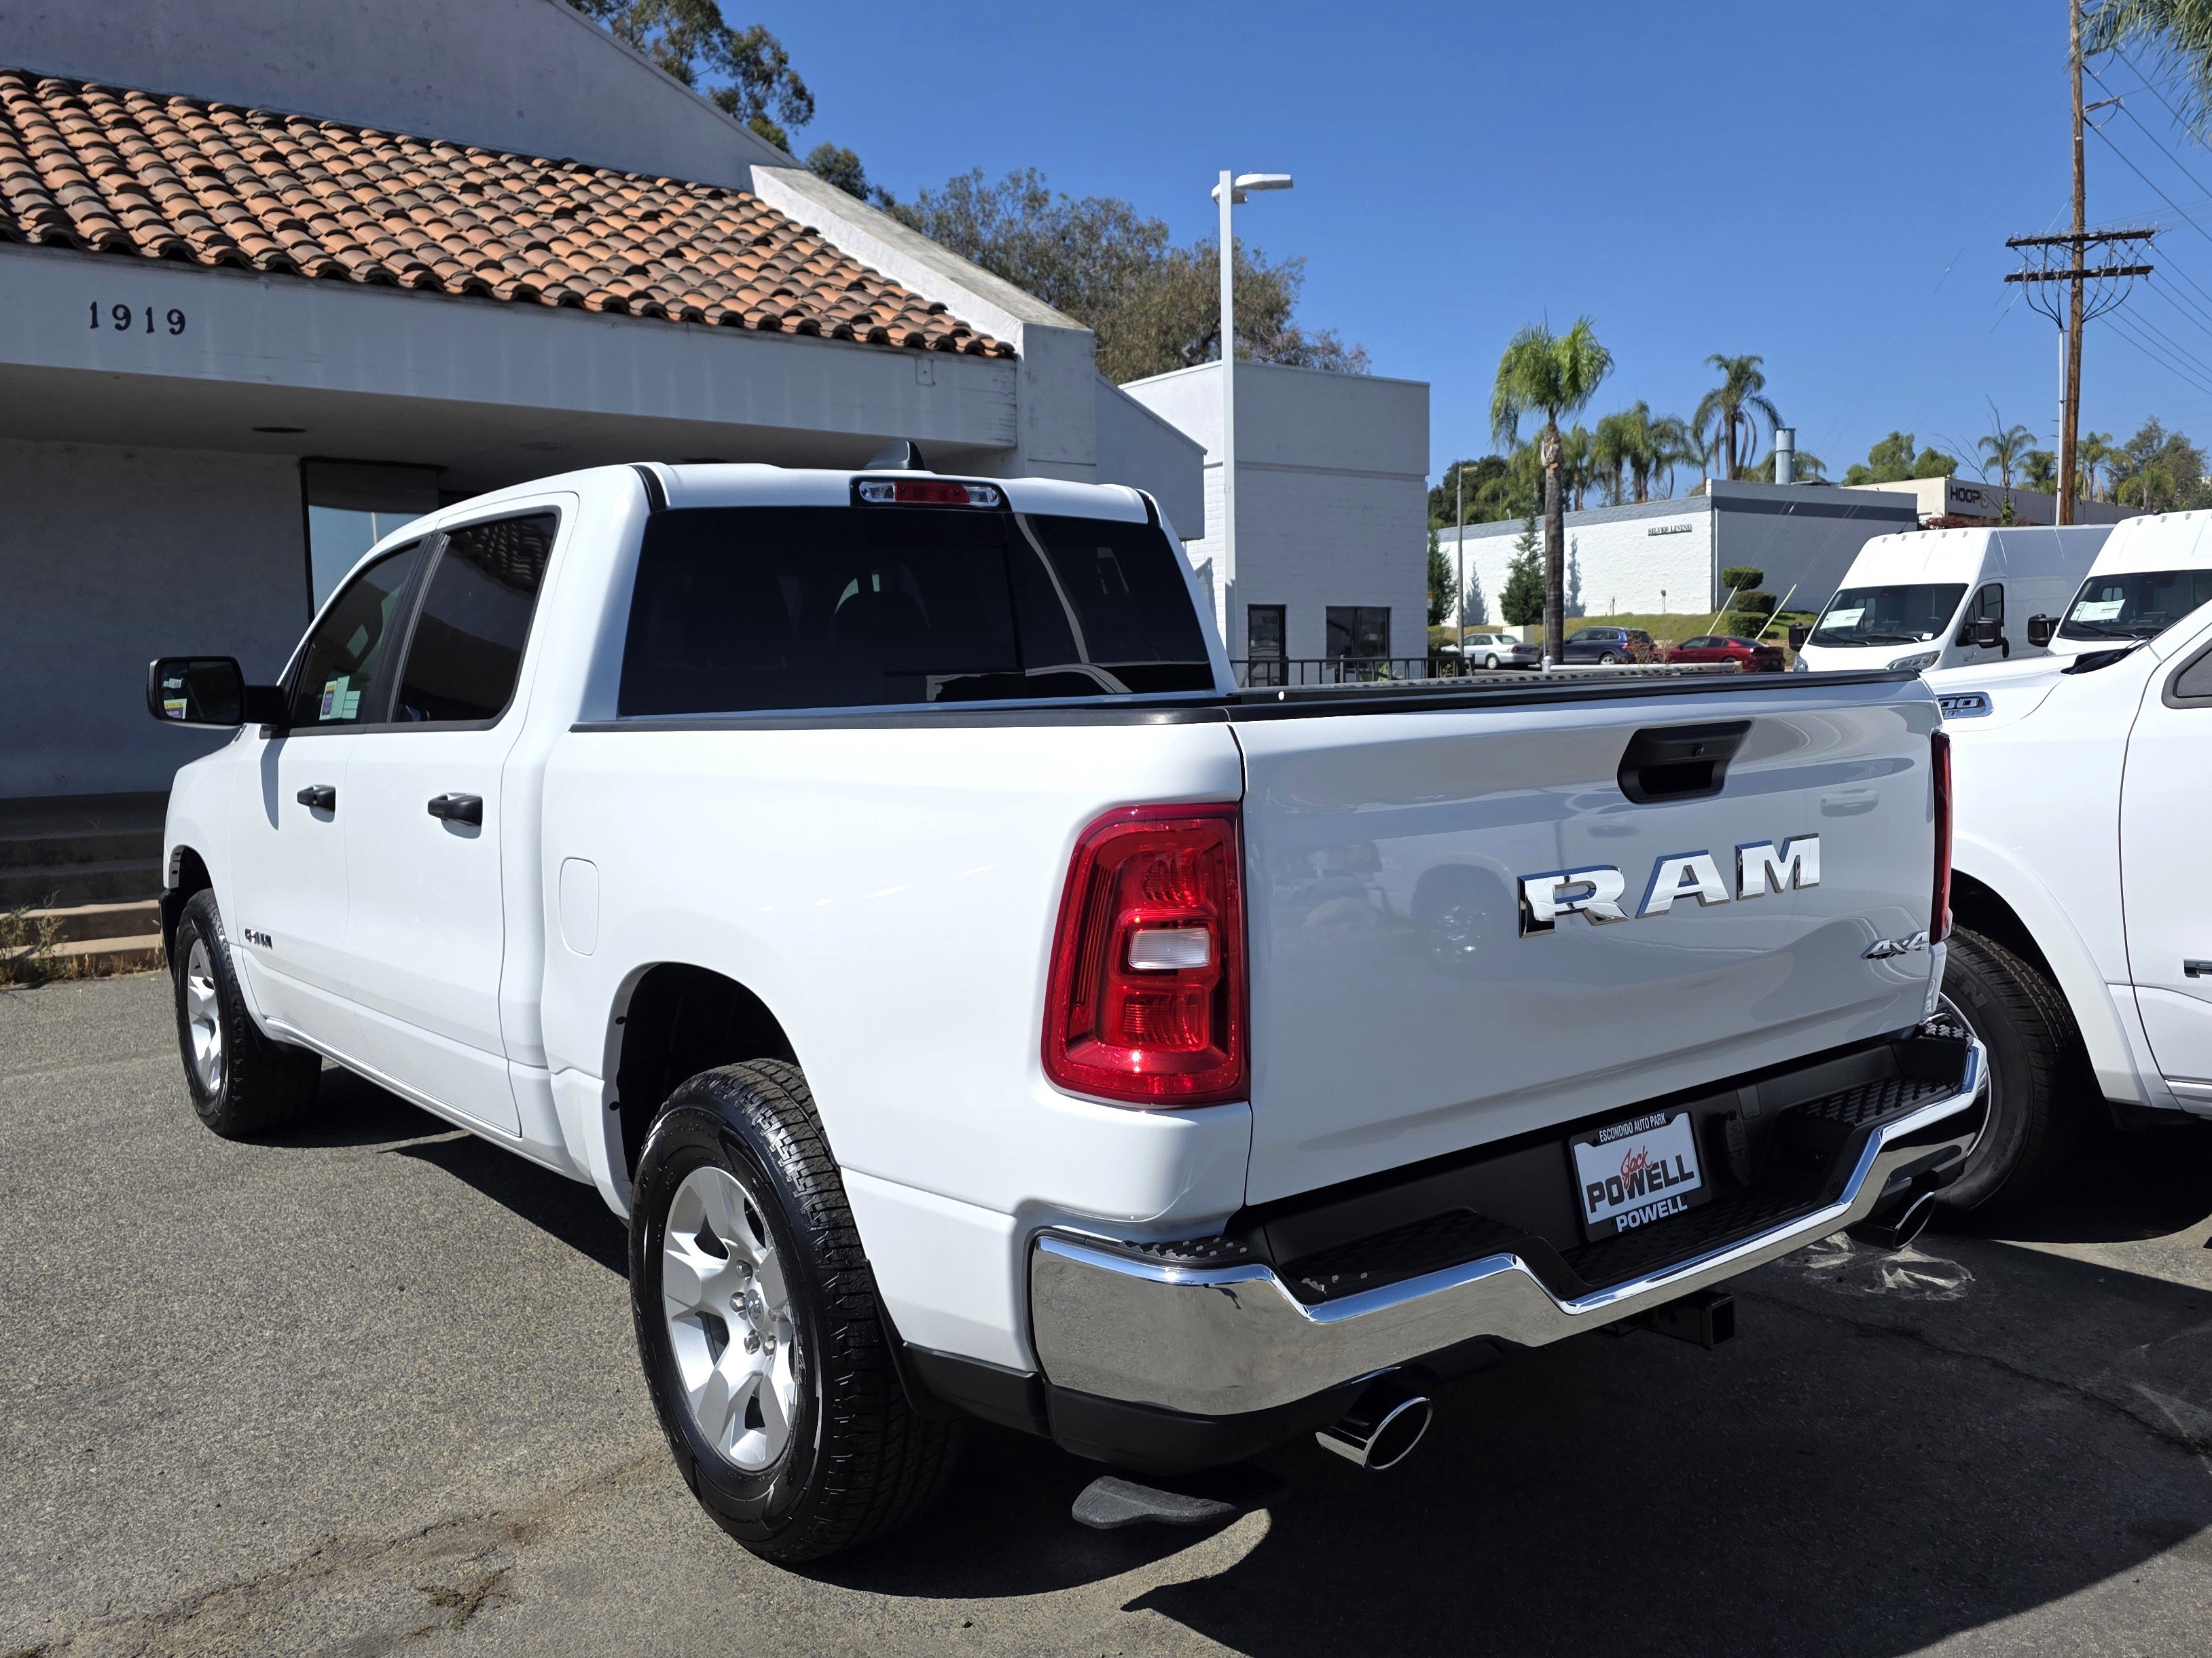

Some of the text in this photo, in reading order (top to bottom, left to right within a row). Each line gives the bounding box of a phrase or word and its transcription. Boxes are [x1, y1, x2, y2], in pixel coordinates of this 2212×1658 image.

[89, 301, 186, 336] 1919
[1648, 526, 1669, 536] SILVER
[1517, 832, 1820, 938] RAM
[1599, 1112, 1667, 1143] ESCONDIDO AUTO PARK
[1586, 1154, 1694, 1213] POWELL
[1620, 1145, 1653, 1190] Jack
[1616, 1196, 1688, 1232] POWELL
